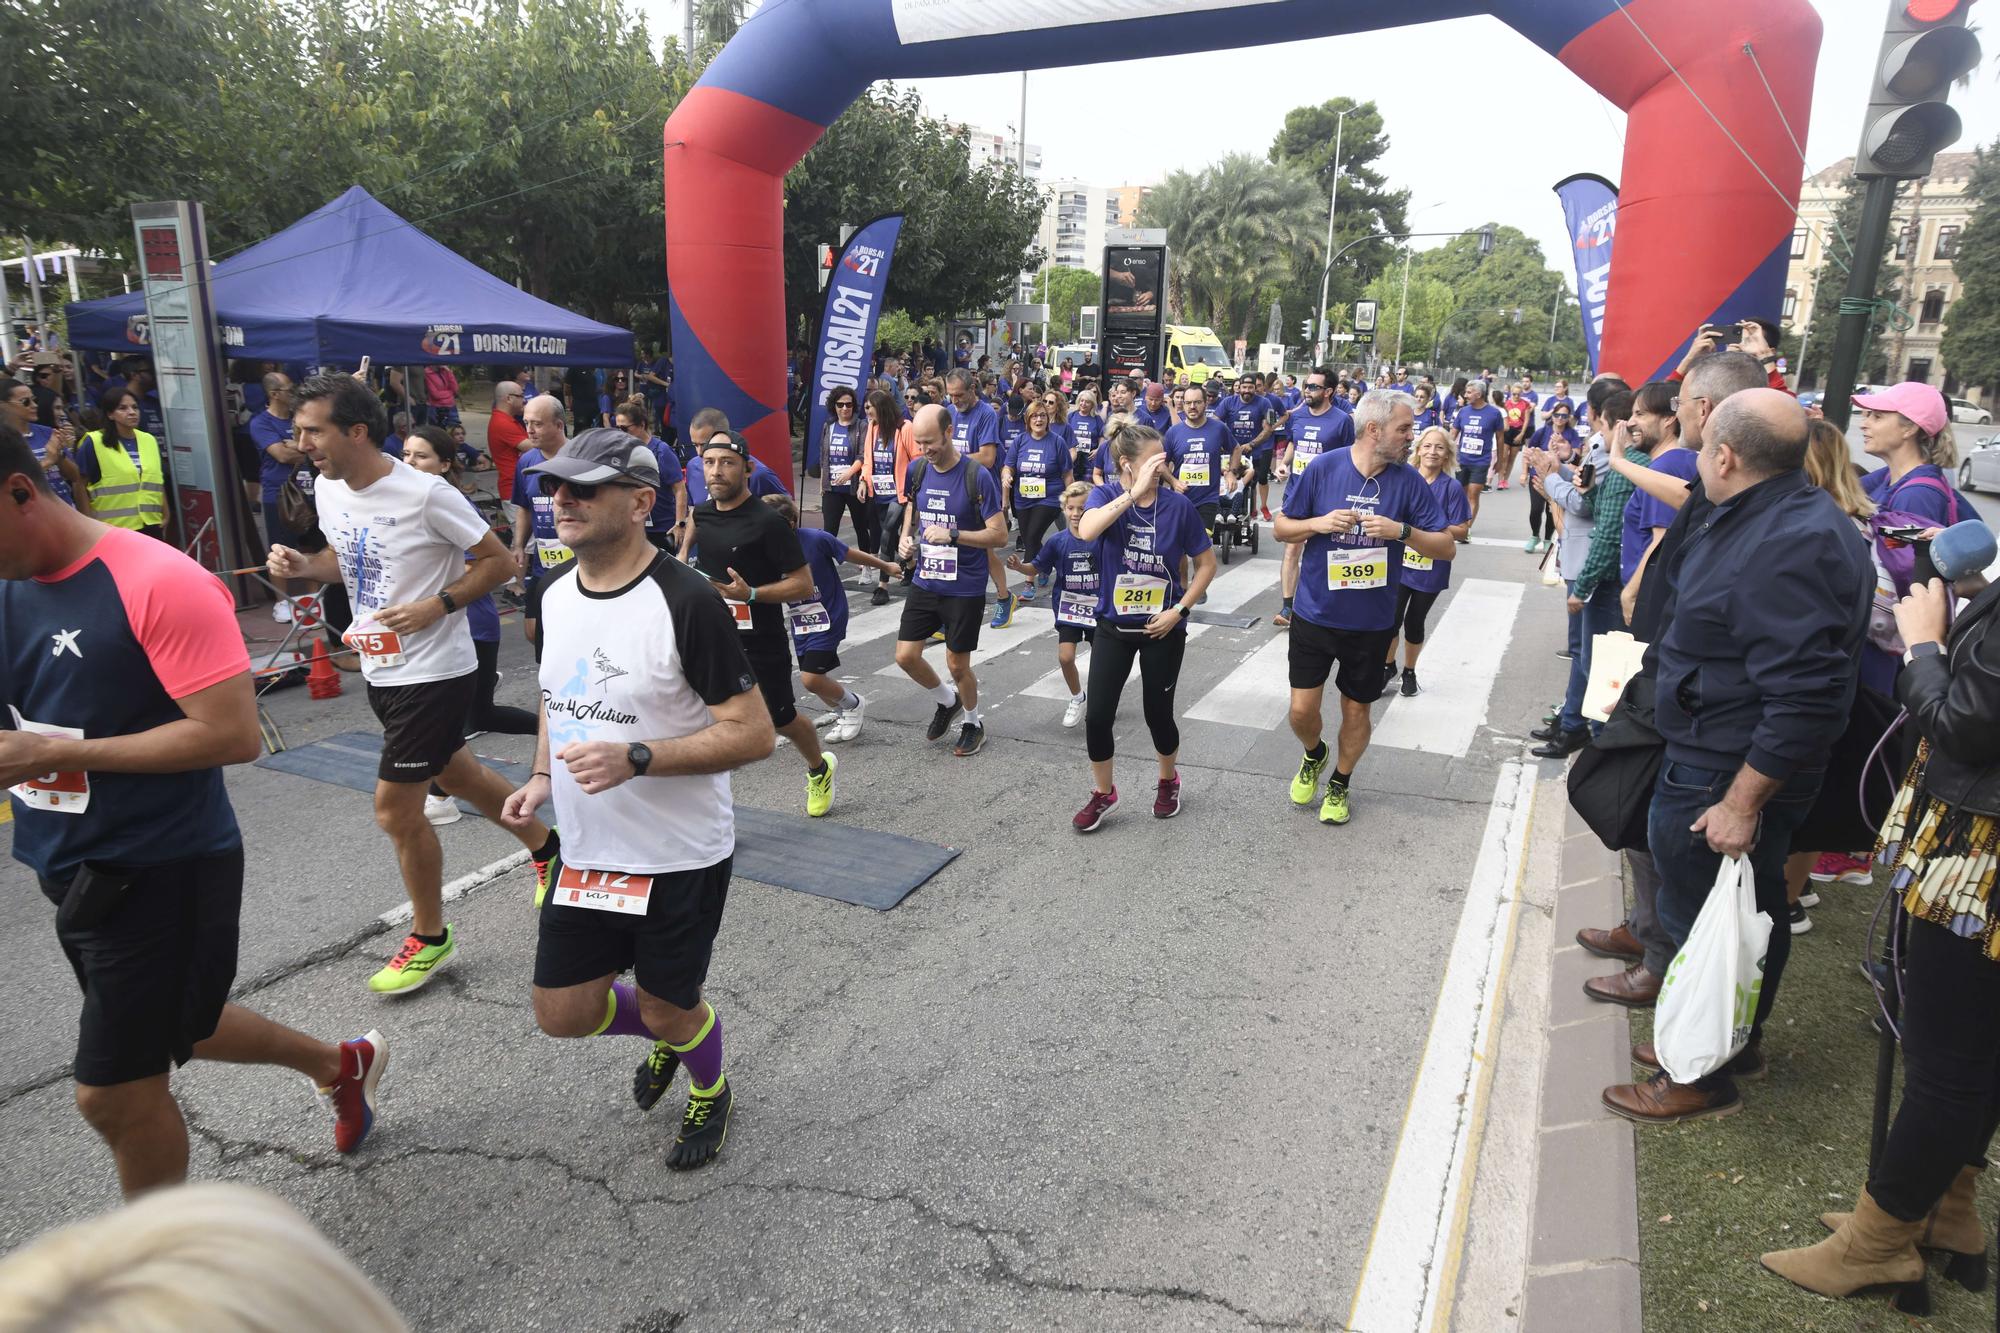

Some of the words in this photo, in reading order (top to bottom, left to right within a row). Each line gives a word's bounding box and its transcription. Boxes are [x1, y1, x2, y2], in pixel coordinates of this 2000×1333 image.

[1587, 199, 1618, 226] DORSAL
[1593, 212, 1617, 246] 21
[859, 245, 885, 259] DORSAL
[856, 256, 880, 277] 21
[437, 334, 461, 356] 21
[473, 333, 566, 355] DORSAL21.COM
[1186, 472, 1203, 480] 345
[544, 550, 563, 560] 151
[1140, 552, 1154, 563] POR
[1155, 555, 1163, 565] TI
[1403, 552, 1424, 564] 147
[923, 558, 945, 571] 451
[1138, 562, 1152, 572] POR
[1341, 564, 1375, 578] 369
[1124, 589, 1152, 602] 281
[1068, 603, 1094, 616] 453
[800, 614, 822, 624] 452
[575, 700, 640, 725] Autism
[586, 891, 610, 900] KIA
